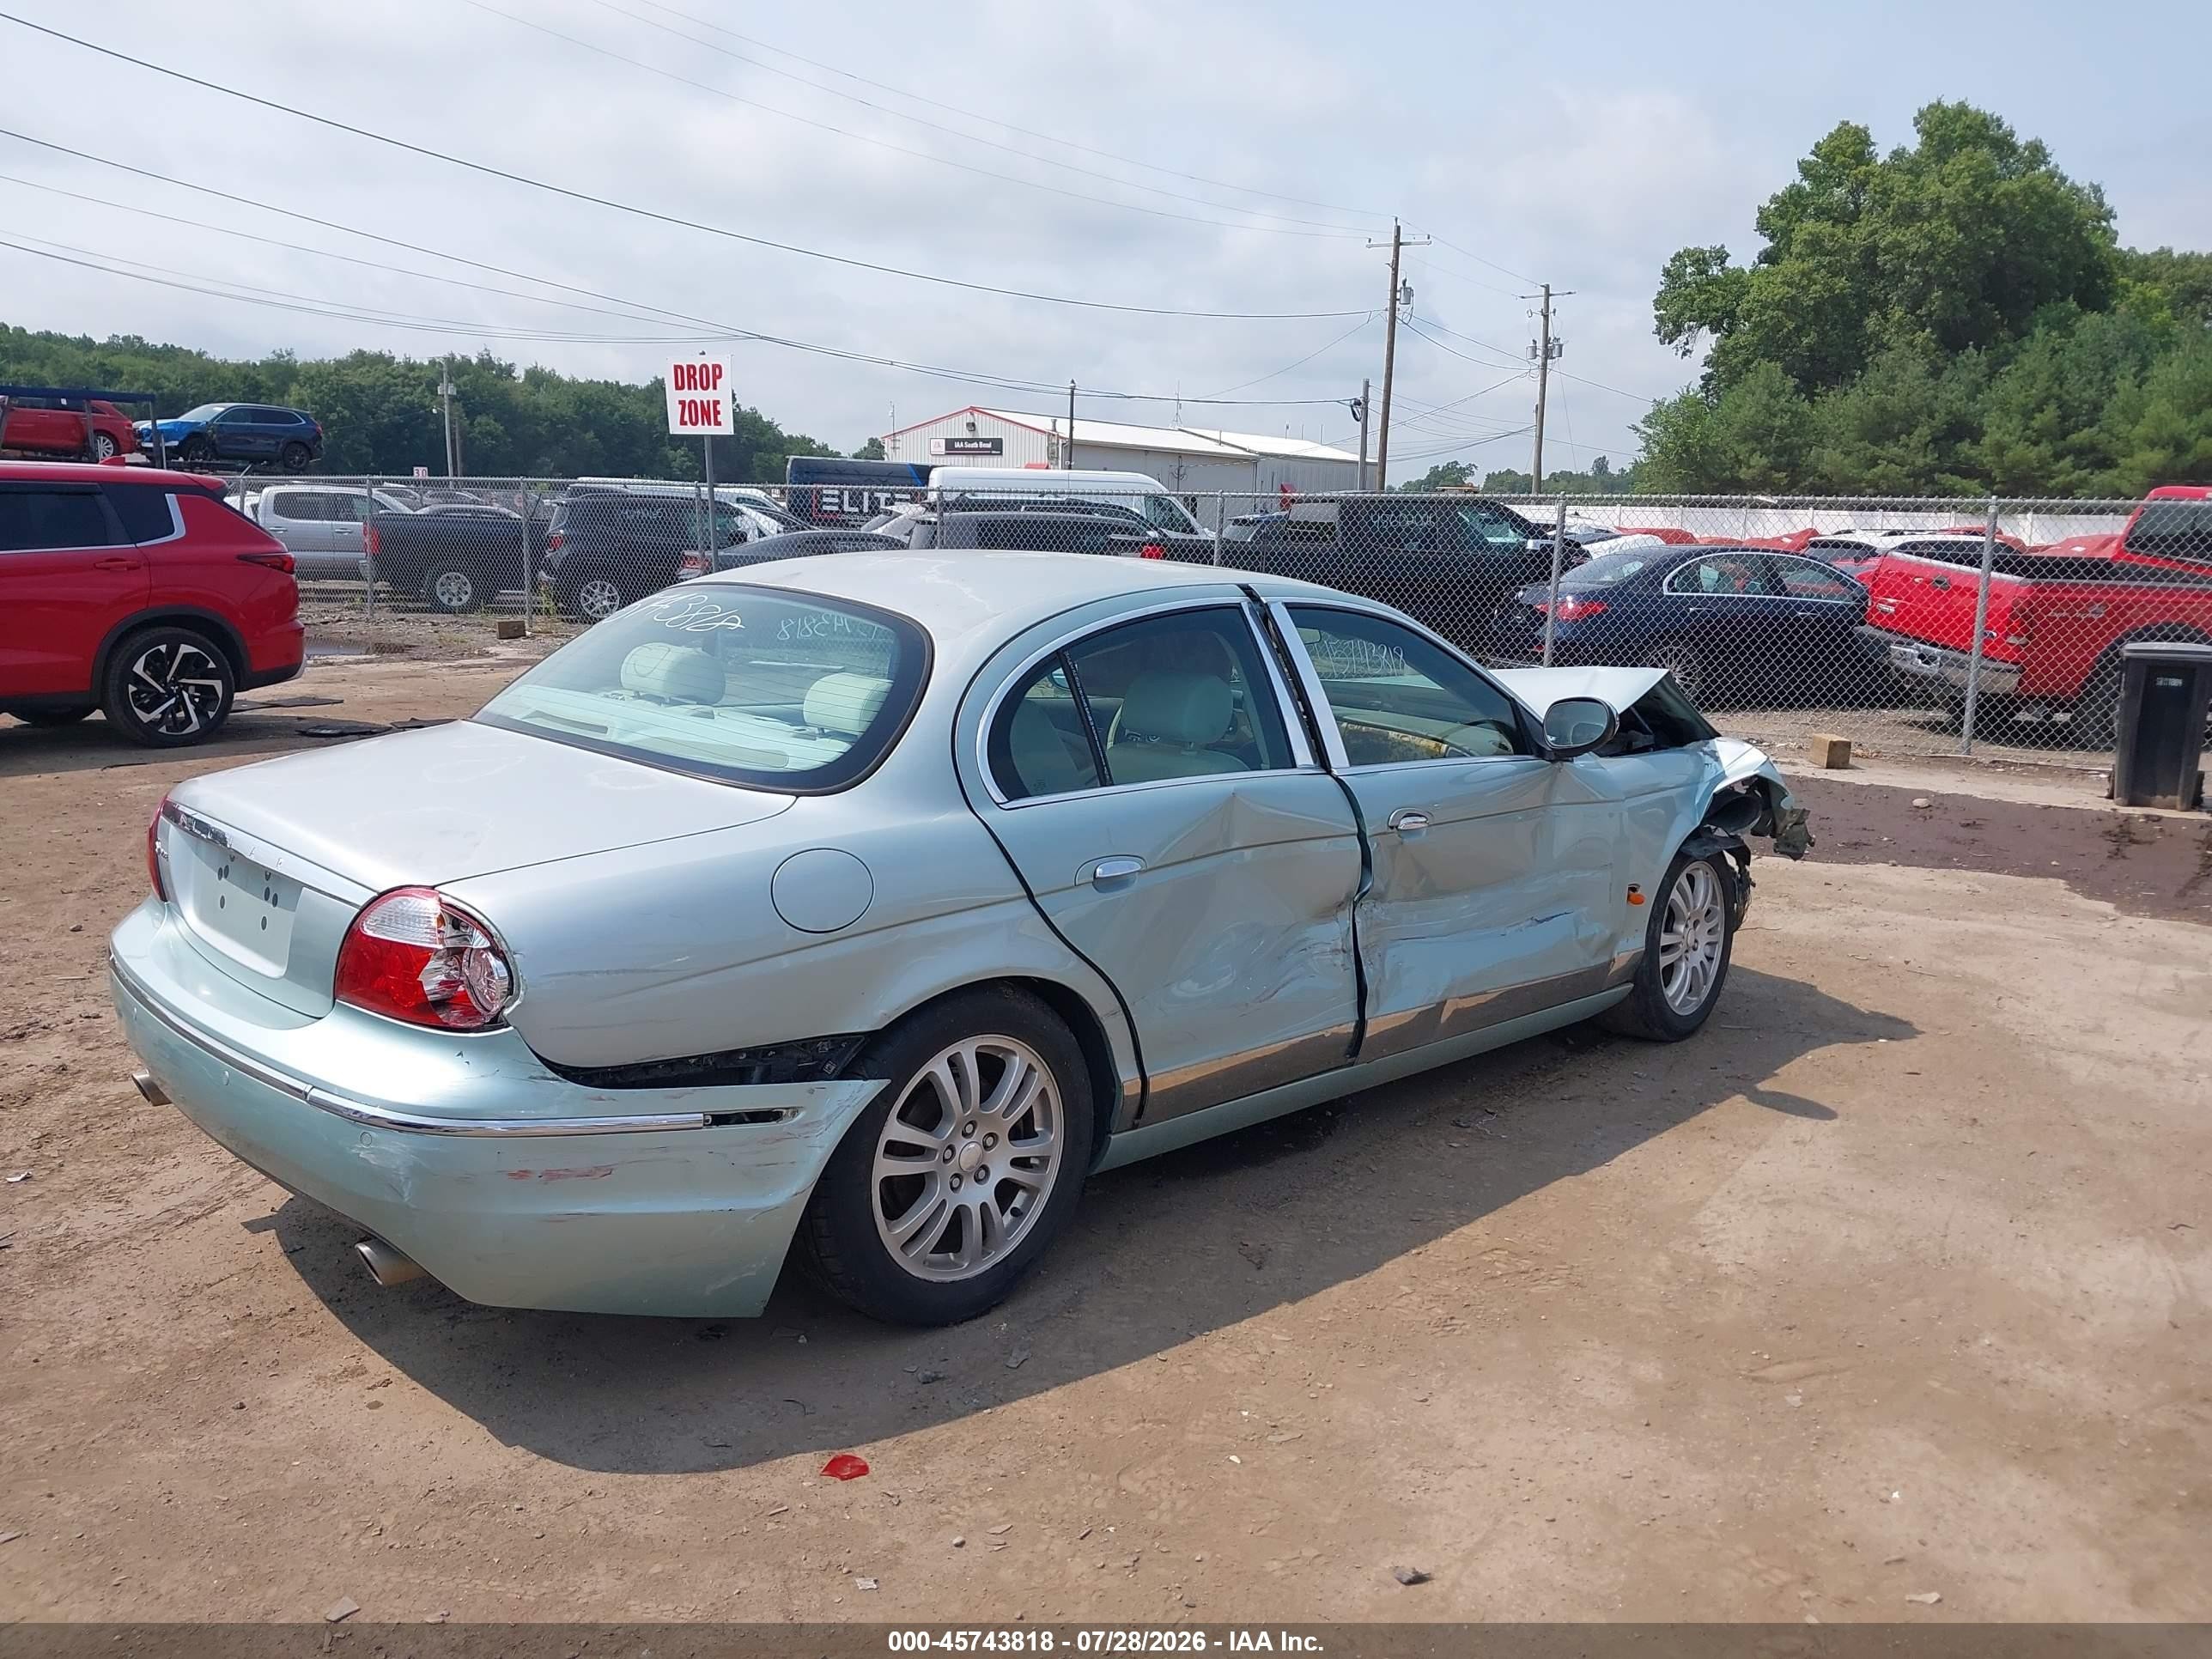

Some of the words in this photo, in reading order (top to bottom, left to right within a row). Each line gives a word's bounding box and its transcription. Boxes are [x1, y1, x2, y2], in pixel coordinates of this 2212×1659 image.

[673, 363, 722, 391] DROP
[678, 399, 722, 426] ZONE
[415, 469, 427, 477] 30
